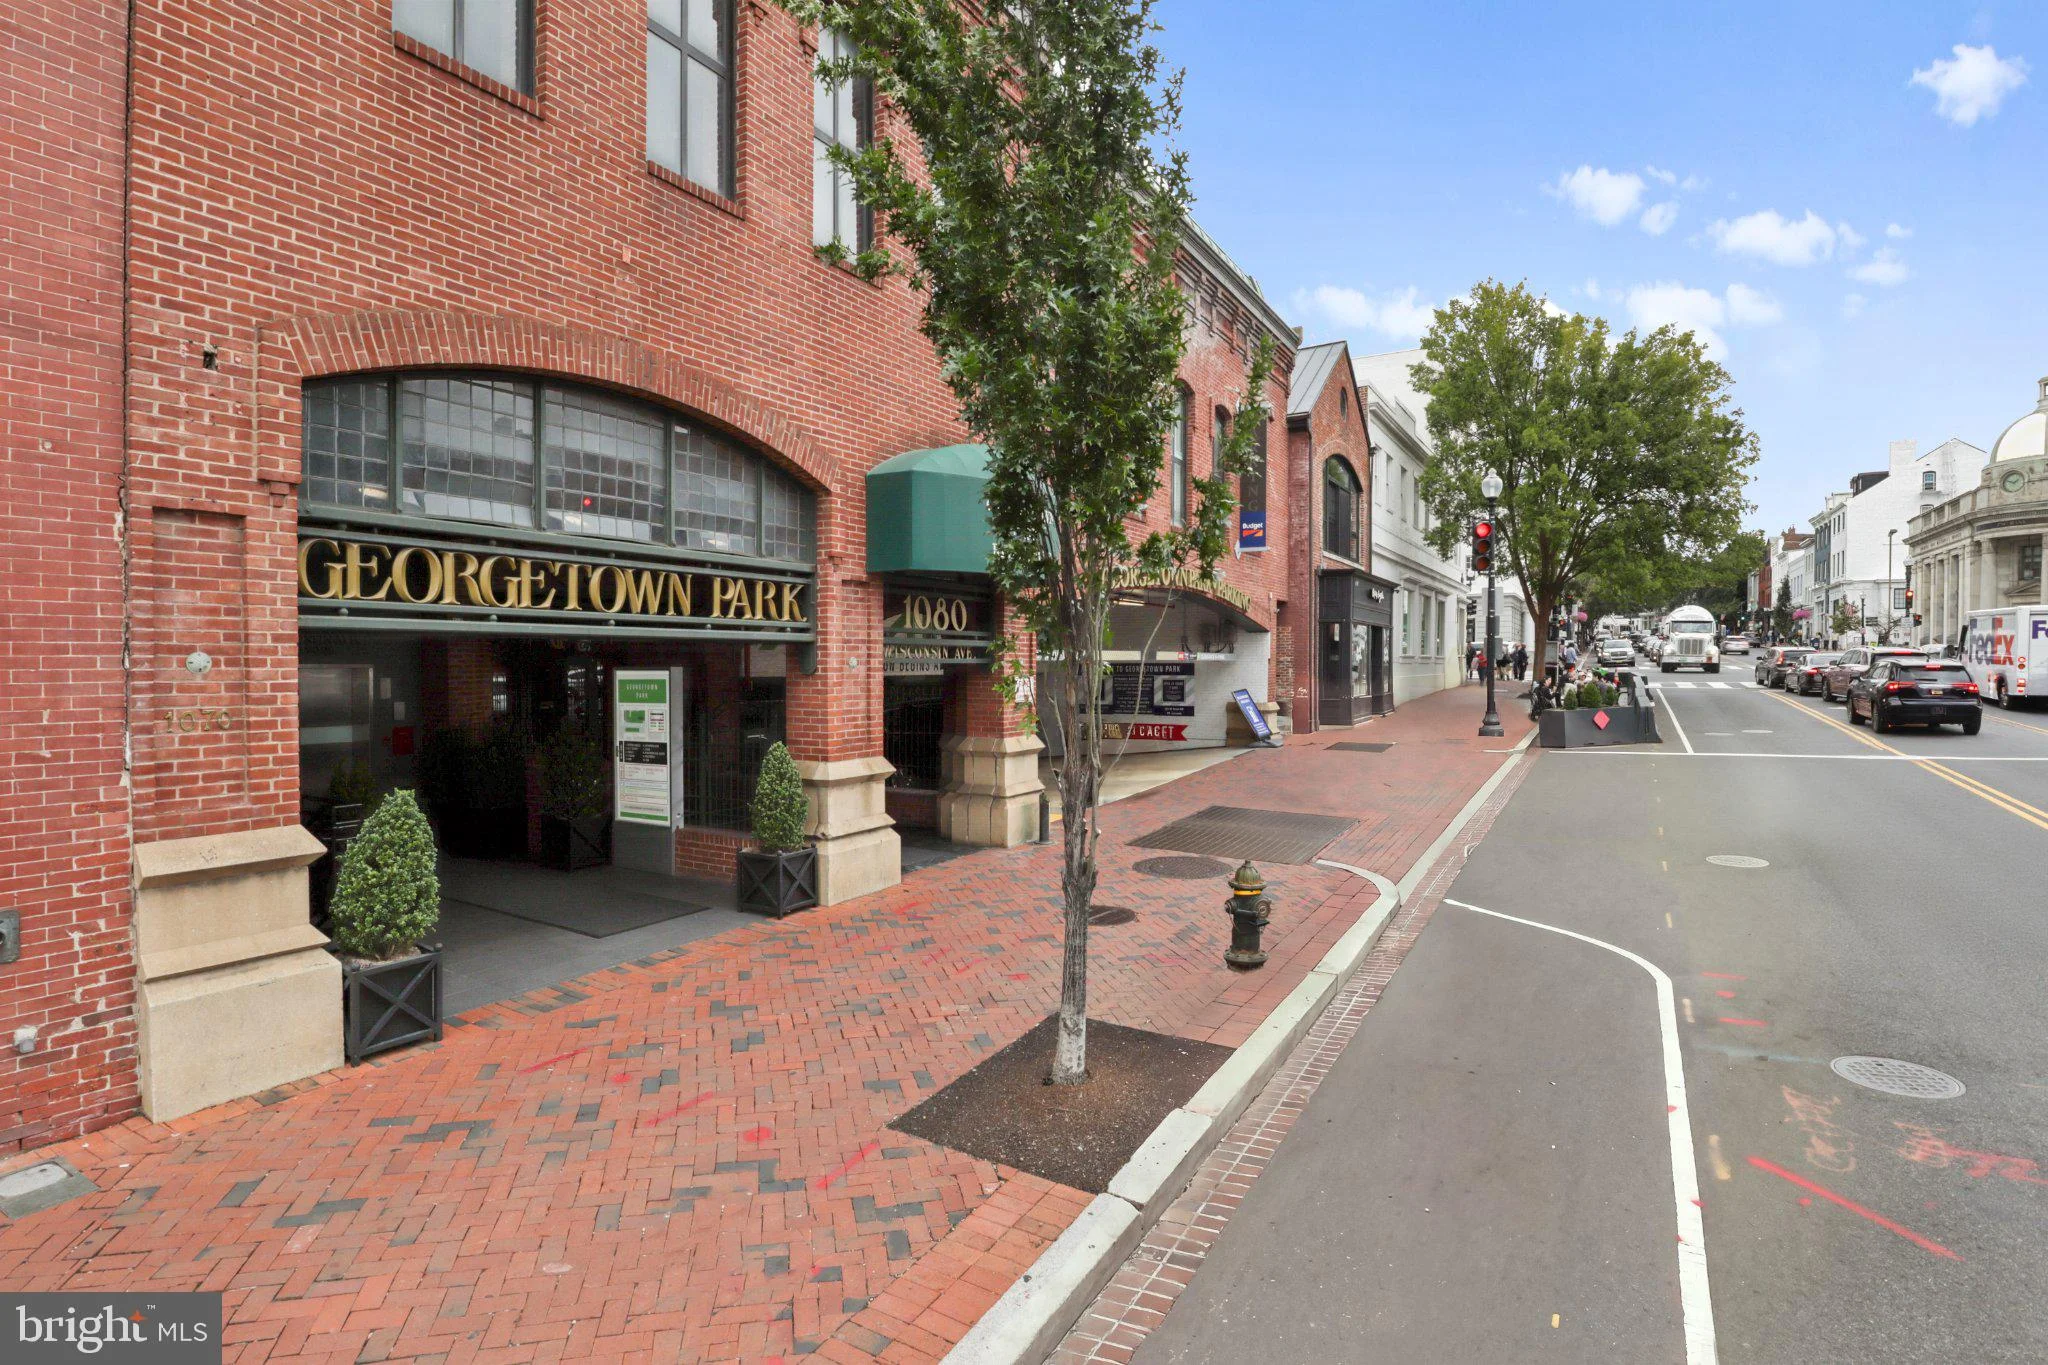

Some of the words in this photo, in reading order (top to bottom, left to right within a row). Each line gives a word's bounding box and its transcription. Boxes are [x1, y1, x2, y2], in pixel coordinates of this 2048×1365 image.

[299, 538, 692, 616] GEORGETOWN
[710, 576, 808, 622] PARK
[903, 594, 967, 631] 1080
[1969, 616, 2015, 666] FedEx
[1125, 665, 1163, 673] GEORTOWN
[1165, 665, 1181, 673] PARK
[164, 709, 233, 733] 1070
